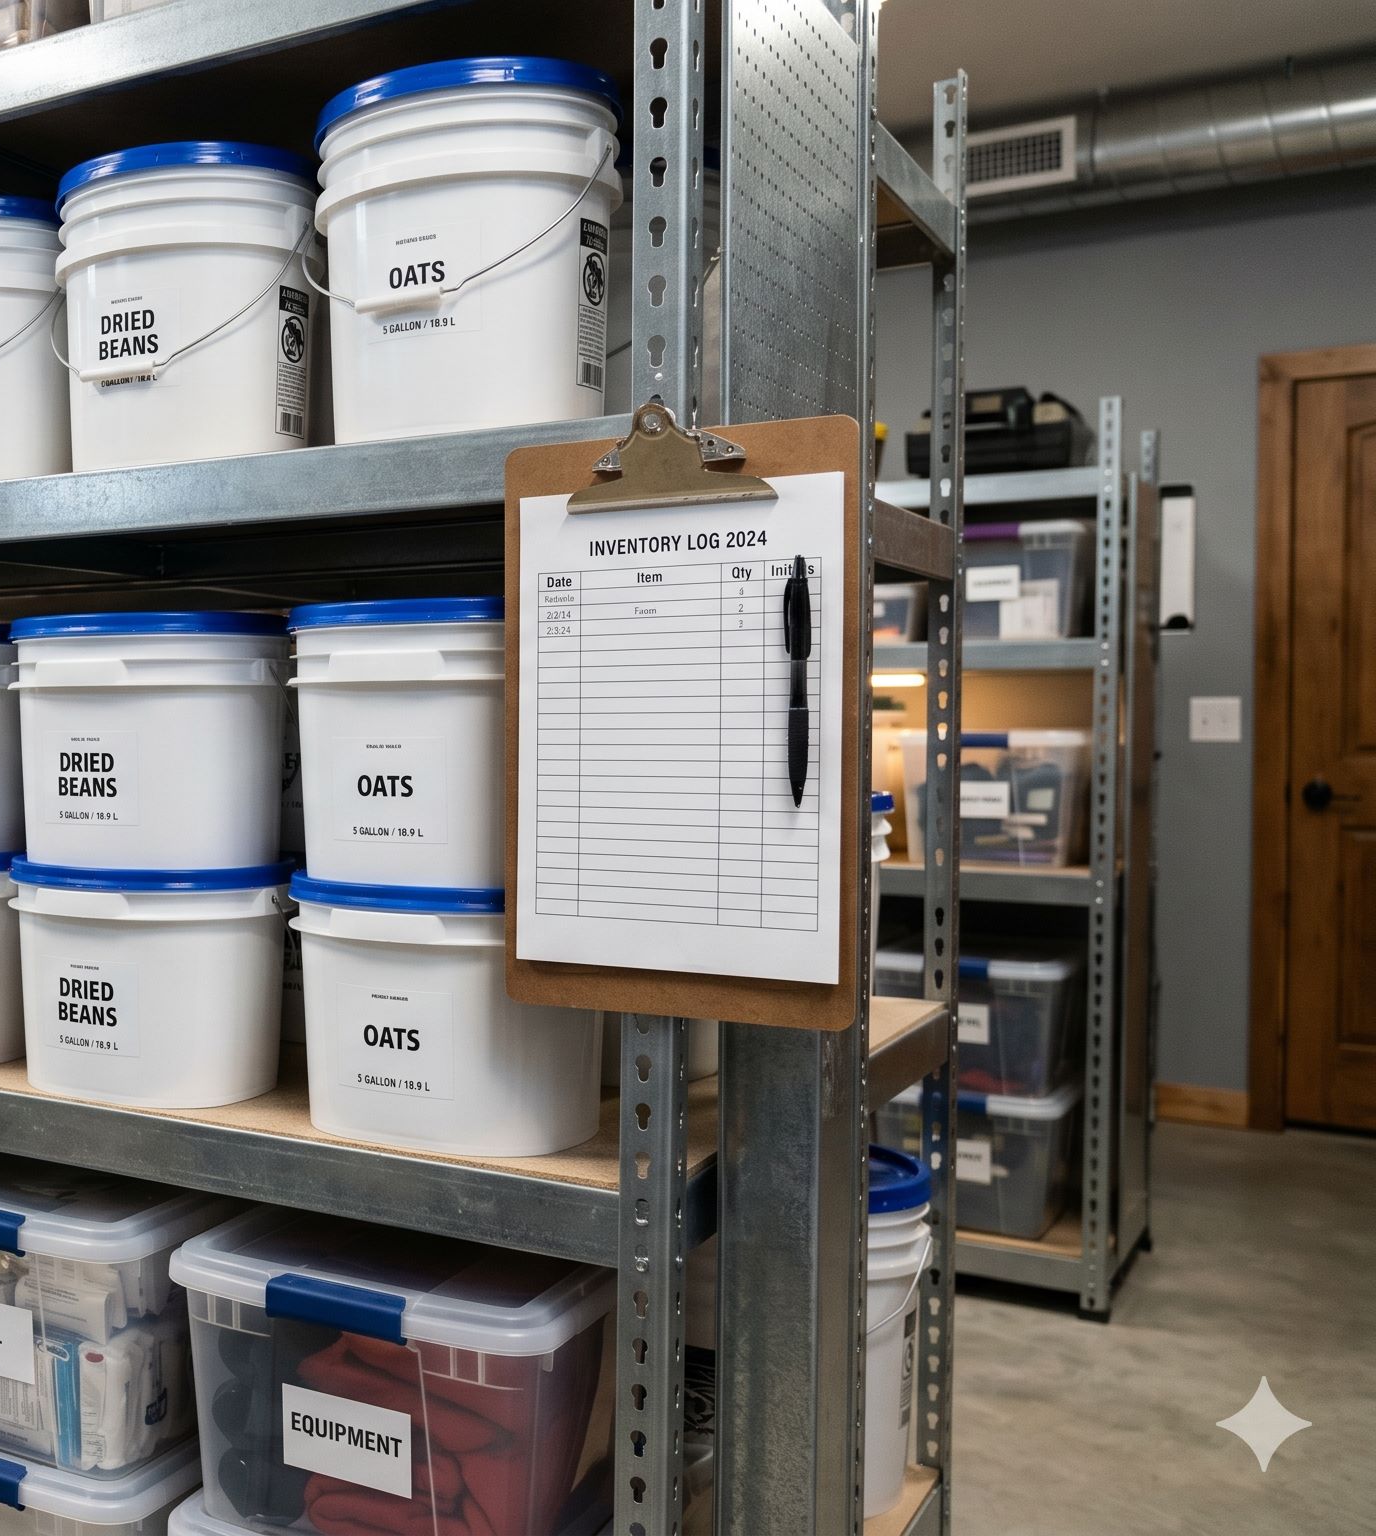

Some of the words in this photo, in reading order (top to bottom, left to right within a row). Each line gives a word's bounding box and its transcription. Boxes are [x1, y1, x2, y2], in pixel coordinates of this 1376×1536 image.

[389, 260, 445, 289] OATS
[101, 309, 155, 335] DRIED
[383, 325, 388, 335] 5
[389, 320, 422, 334] GALLON
[430, 318, 448, 328] 18.9
[450, 317, 456, 326] L
[99, 334, 159, 360] BEANS
[589, 534, 682, 557] INVENTORY
[687, 533, 720, 551] LOG
[726, 530, 768, 548] 2024
[637, 572, 663, 583] Item
[732, 566, 752, 581] Qty
[771, 564, 815, 577] Inits
[547, 576, 572, 588] Date
[738, 603, 744, 613] 2
[60, 752, 114, 773] DRIED
[58, 776, 118, 798] BEANS
[357, 774, 414, 798] OATS
[64, 811, 90, 820] GALLON
[96, 812, 111, 820] 18.9
[113, 812, 118, 821] L
[353, 826, 358, 835] 5
[359, 826, 390, 836] GALLON
[398, 828, 416, 837] 18.9
[418, 828, 424, 838] L
[59, 977, 114, 1002] DRIED
[58, 1001, 118, 1027] BEANS
[64, 1035, 90, 1048] GALLON
[113, 1042, 119, 1051] L
[363, 1024, 421, 1052] OATS
[357, 1073, 362, 1083] 5
[364, 1075, 396, 1088] GALLON
[404, 1080, 422, 1091] 18.9
[425, 1082, 430, 1092] L
[291, 1411, 402, 1458] EQUIPMENT
